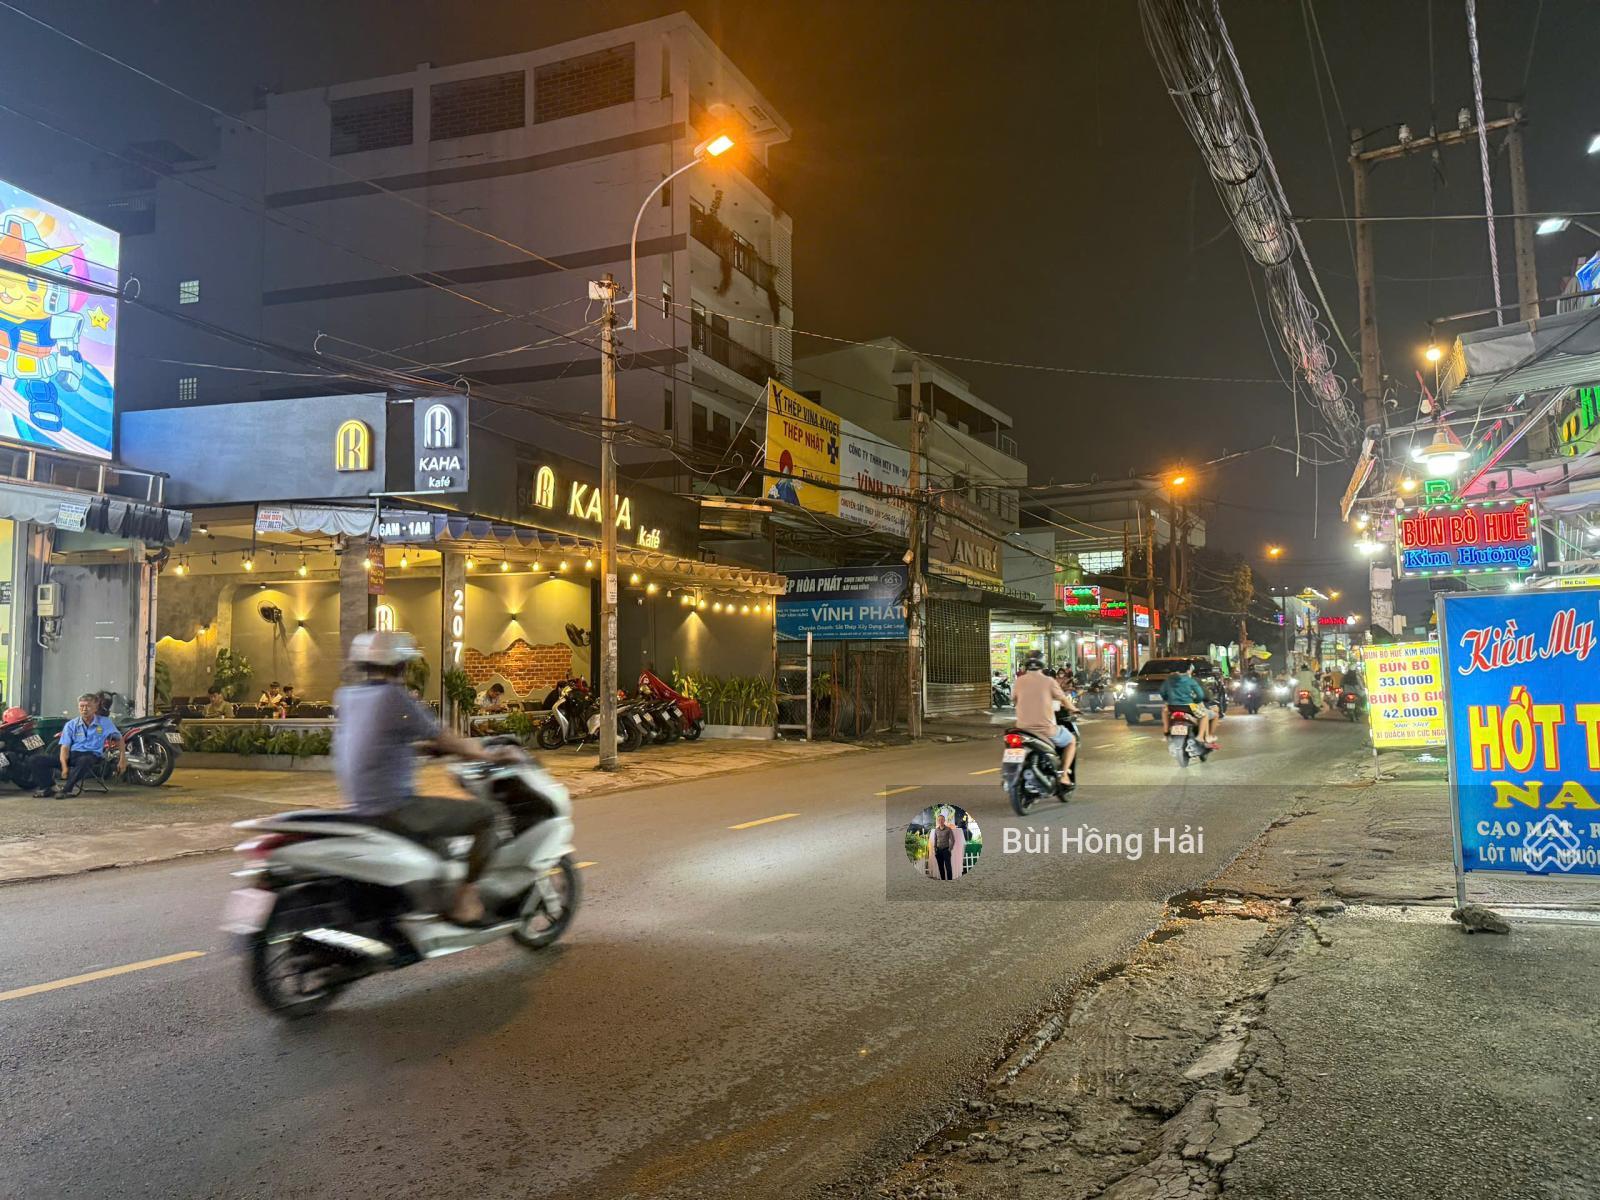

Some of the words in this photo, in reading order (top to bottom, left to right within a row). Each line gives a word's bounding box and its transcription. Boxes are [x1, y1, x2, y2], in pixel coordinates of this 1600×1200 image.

[783, 396, 802, 417] THÉP
[802, 406, 819, 427] VINA
[819, 415, 840, 438] KYOEI
[783, 421, 804, 443] THÉP
[804, 432, 825, 454] NHẬT
[419, 456, 460, 472] KAHA
[428, 476, 450, 488] kafé
[379, 522, 400, 536] 6AM
[409, 521, 431, 535] 1AM
[637, 525, 661, 549] kafé
[1402, 507, 1446, 548] BÚN
[1449, 509, 1478, 545] BÒ
[1484, 502, 1530, 543] HUẾ
[954, 538, 976, 567] AN
[976, 543, 998, 573] TRÍ
[1404, 548, 1453, 569] Kim
[1456, 545, 1534, 568] Hương
[785, 577, 796, 593] ÉP
[796, 576, 816, 592] HÒA
[817, 574, 842, 591] PHÁT
[811, 603, 853, 622] VĨNH
[859, 602, 904, 620] PHÁT
[453, 589, 464, 664] 207
[1404, 648, 1418, 656] KIM
[1458, 618, 1538, 675] Kiều
[1539, 608, 1597, 661] My
[1379, 675, 1434, 687] 33.000Đ
[1383, 706, 1438, 719] 42.000Đ
[1468, 685, 1566, 773] HỚT
[1476, 820, 1521, 839] CẠO
[1525, 817, 1573, 841] MẶT
[1479, 843, 1506, 864] LỘT
[1556, 845, 1600, 868] NHUỘ
